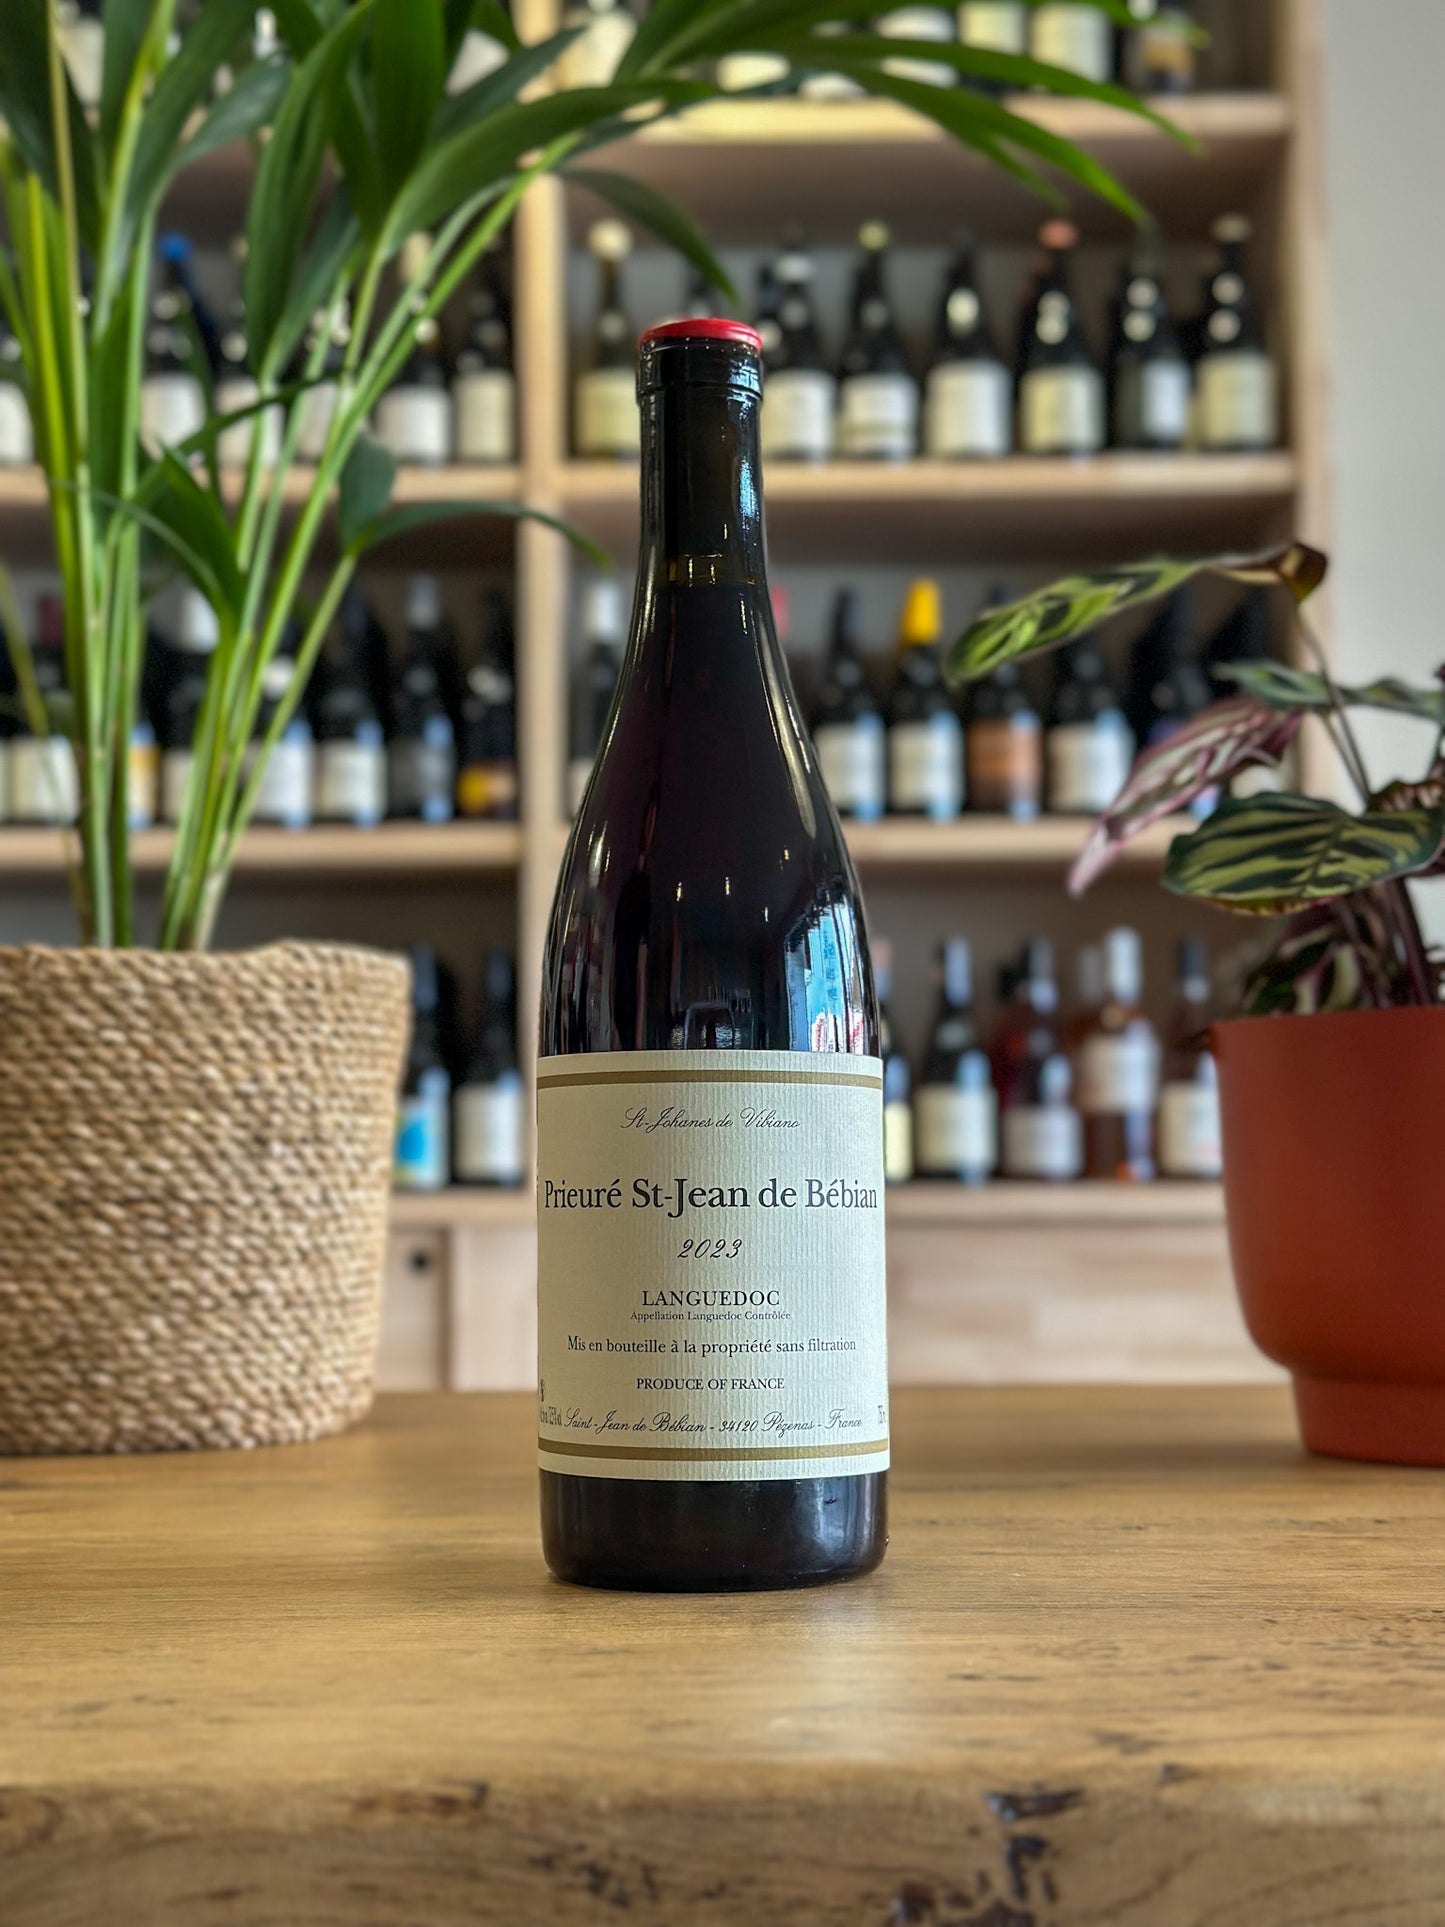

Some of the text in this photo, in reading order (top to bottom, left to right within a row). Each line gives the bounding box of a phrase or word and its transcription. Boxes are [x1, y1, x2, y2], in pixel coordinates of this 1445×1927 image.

[620, 1106, 801, 1133] St-Johanes de Vibiano
[545, 1178, 877, 1218] Prieuré St-Jean de Bébian
[677, 1239, 743, 1259] 2023
[642, 1290, 780, 1306] LANGUEDOC
[630, 1310, 791, 1322] Appellation Languedoc Contrôlée
[567, 1335, 857, 1358] Mis en bouteille à la propriété sans filtration
[636, 1378, 785, 1390] PRODUCE OF FRANCE
[633, 1417, 648, 1431] de
[649, 1411, 706, 1432] Bébian
[718, 1420, 759, 1432] 34120
[761, 1411, 815, 1438] Pézenas
[825, 1408, 863, 1429] France
